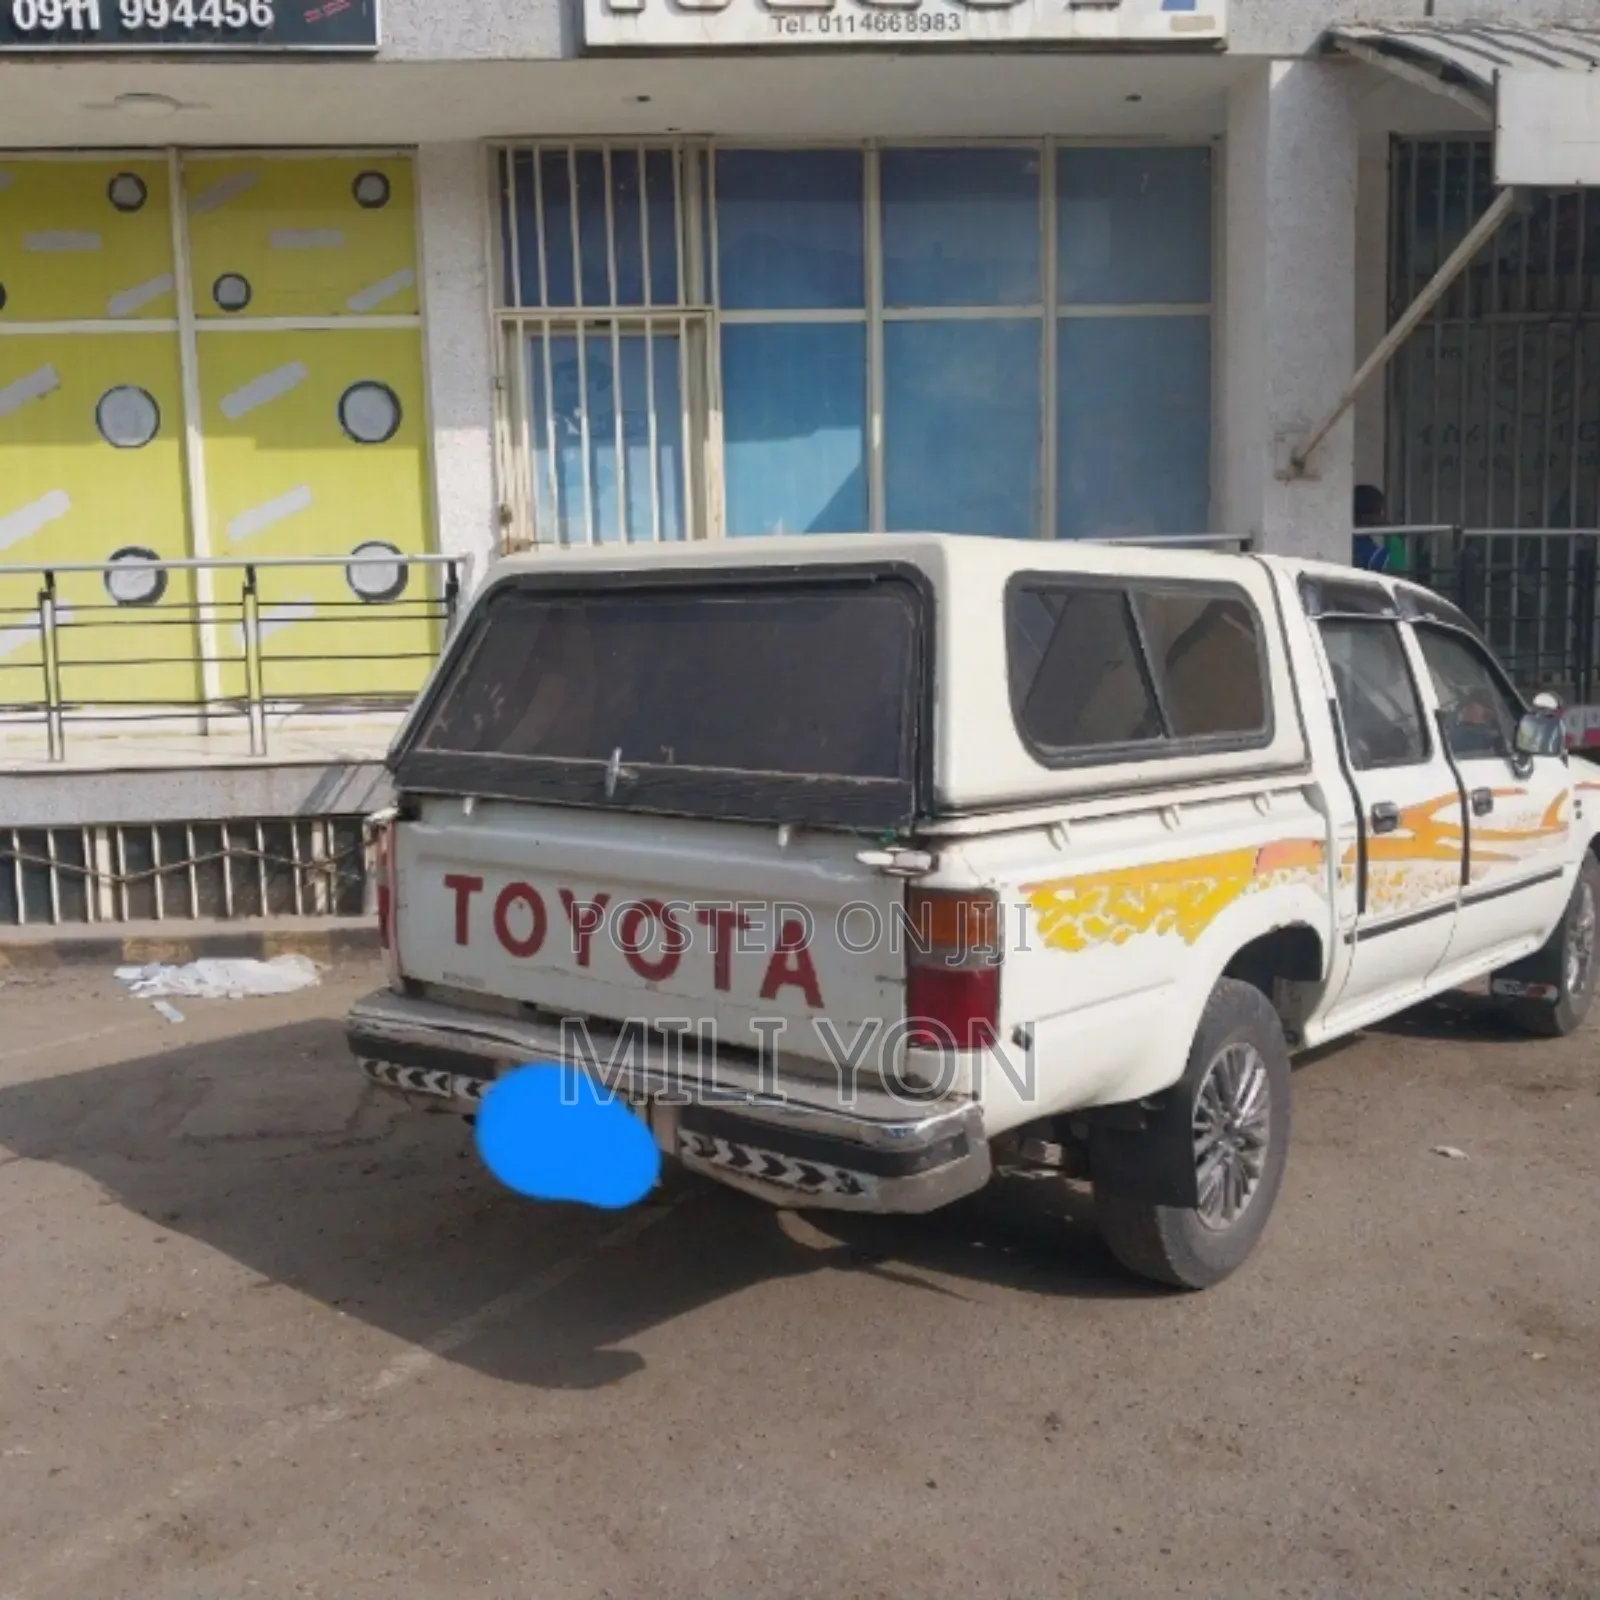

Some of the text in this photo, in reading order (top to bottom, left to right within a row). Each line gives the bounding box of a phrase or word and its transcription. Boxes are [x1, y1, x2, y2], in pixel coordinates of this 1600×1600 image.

[12, 0, 101, 30] 0911
[119, 0, 275, 29] 994456
[770, 14, 813, 33] Tel.
[443, 874, 825, 1008] TOYOTA
